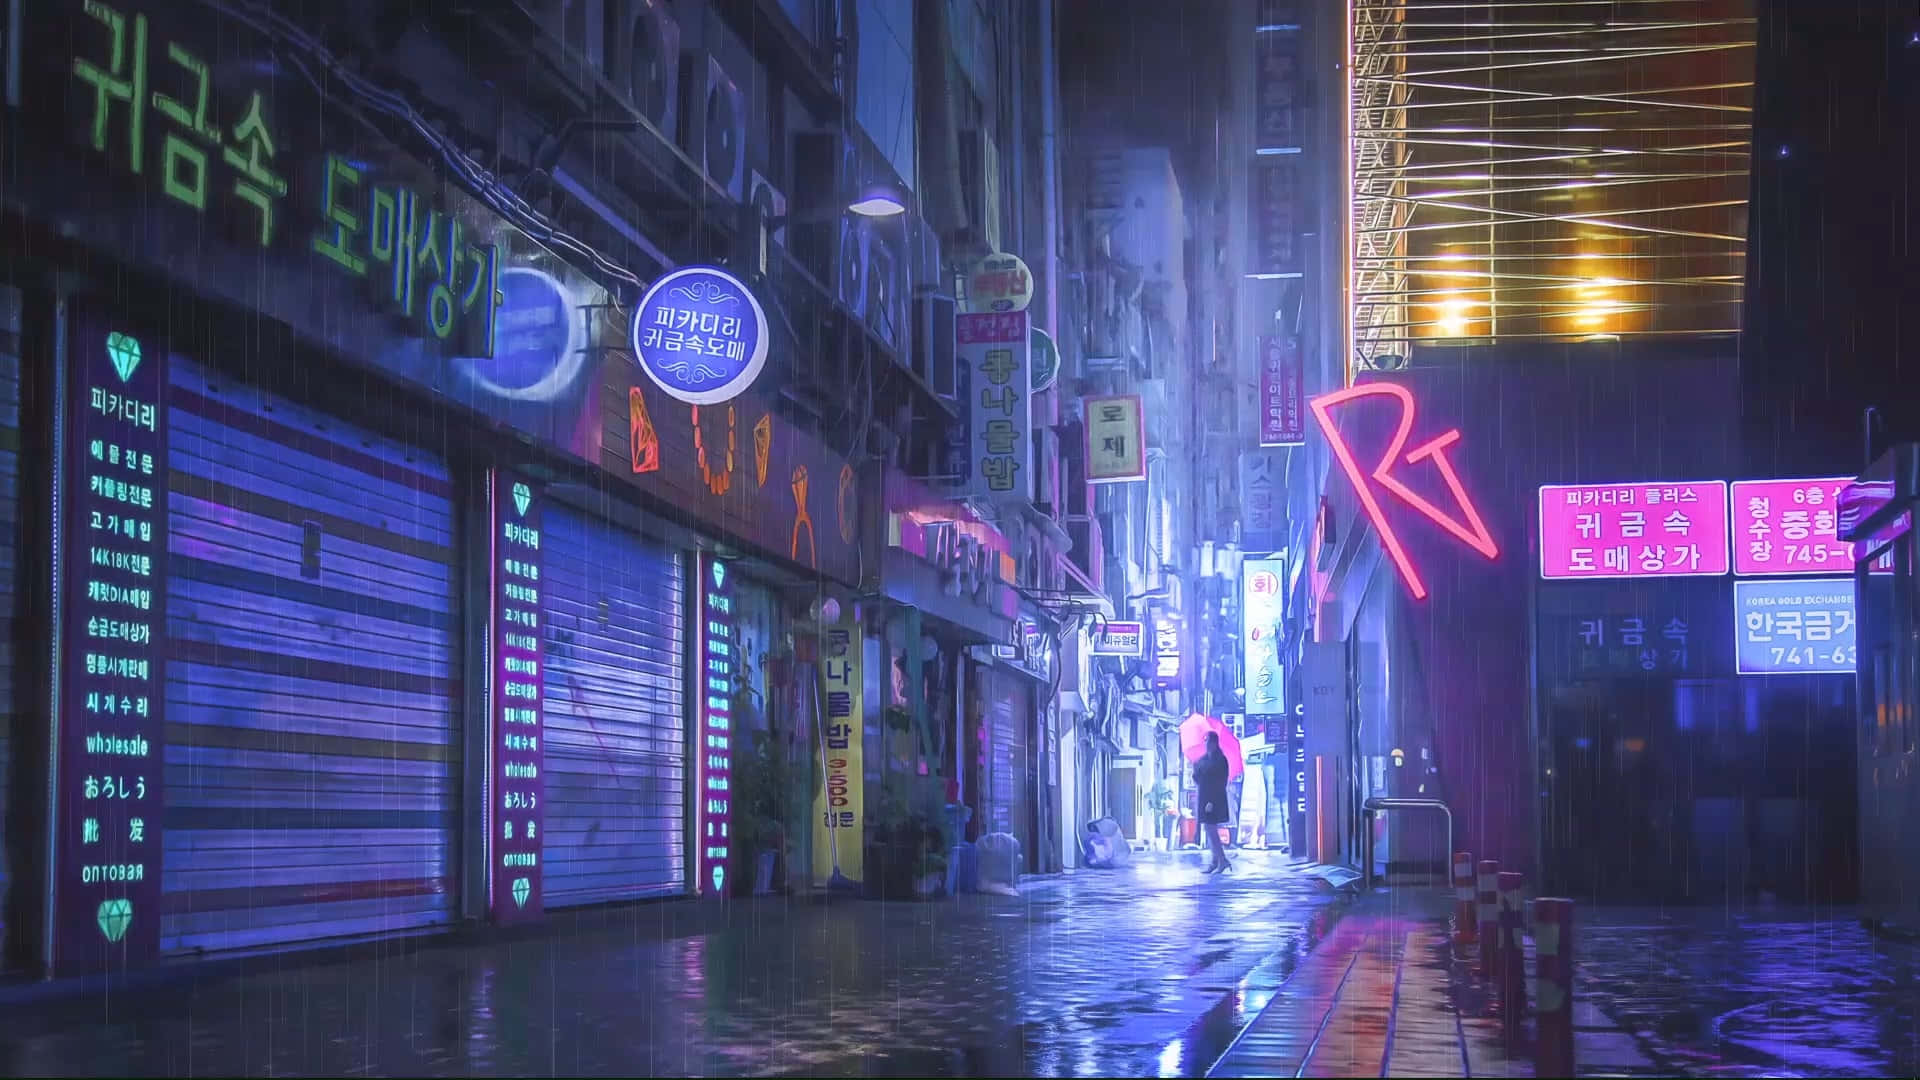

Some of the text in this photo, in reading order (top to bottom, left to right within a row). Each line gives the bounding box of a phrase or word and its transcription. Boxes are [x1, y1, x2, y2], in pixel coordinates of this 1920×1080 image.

[74, 0, 503, 352] 귀금속 도매상가
[654, 306, 742, 340] 피카디리
[643, 327, 746, 362] 귀금속도매
[91, 388, 155, 432] 피카디리
[1567, 487, 1697, 506] 피카디리 플러스
[1793, 486, 1825, 505] 6층
[90, 511, 151, 542] 고가매입
[504, 523, 538, 549] 피카디리
[1576, 509, 1690, 538] 귀금속
[1569, 543, 1701, 572] 도매상가
[86, 693, 148, 717] 시계수리
[86, 732, 148, 757] wholesale
